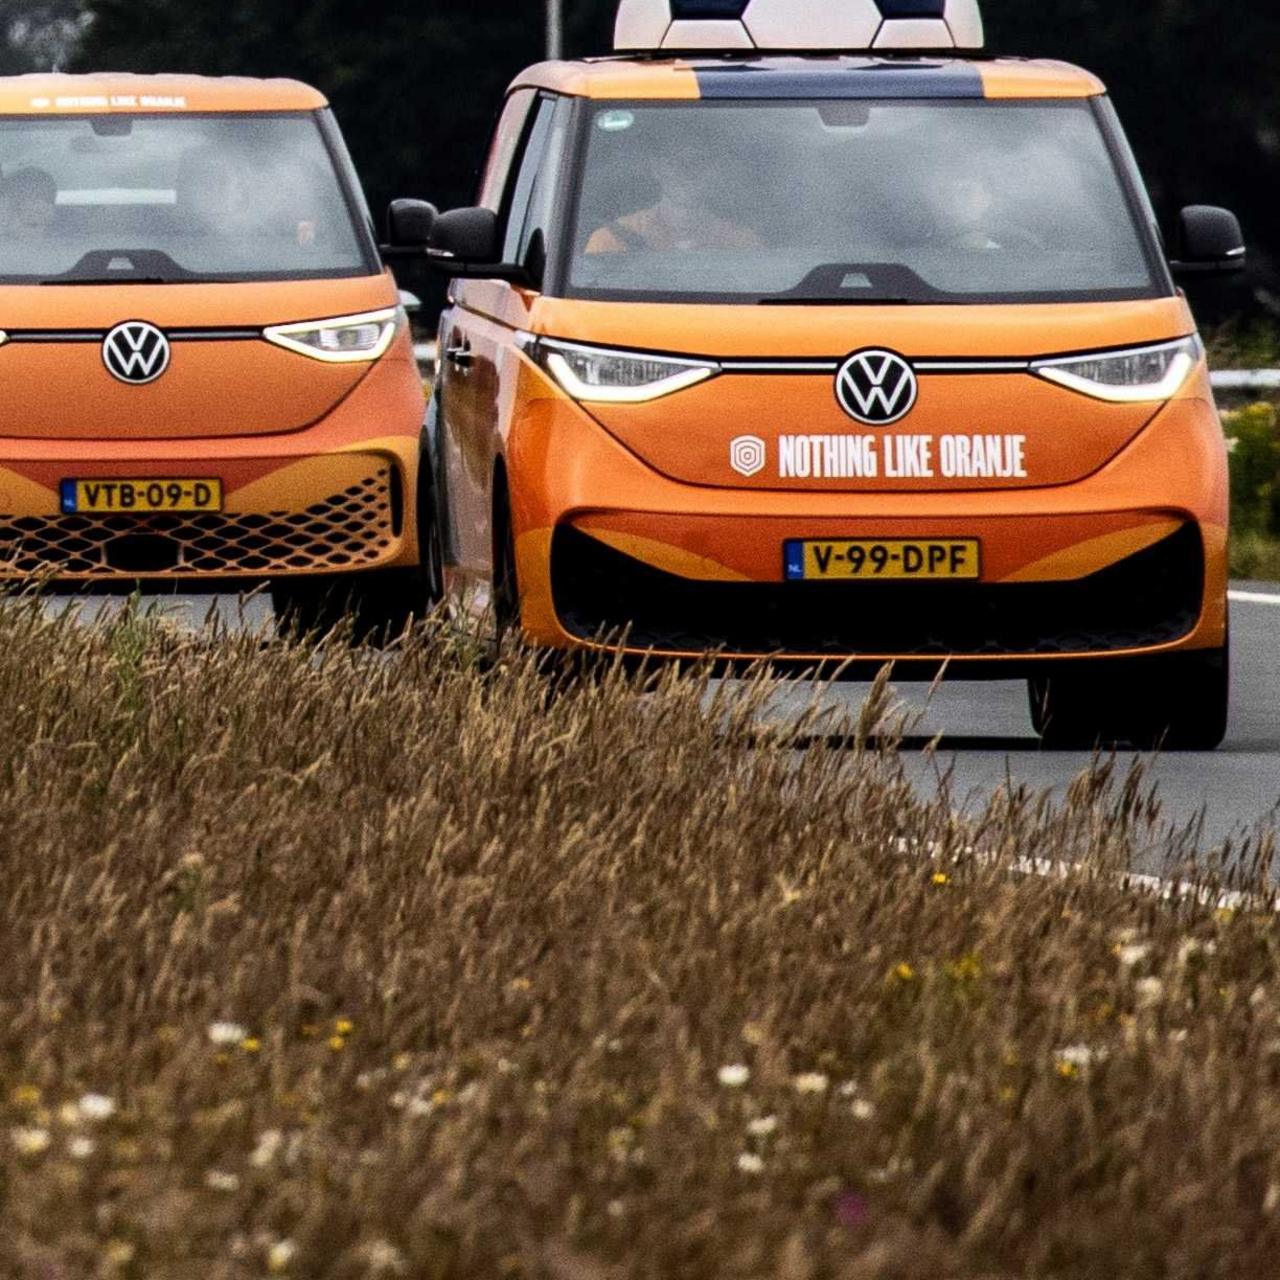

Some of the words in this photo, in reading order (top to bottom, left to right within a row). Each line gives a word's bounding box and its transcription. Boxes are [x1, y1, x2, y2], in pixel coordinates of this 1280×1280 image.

[779, 435, 877, 477] NOTHING
[884, 434, 933, 477] LIKE
[940, 434, 1027, 477] ORANJE
[83, 483, 212, 508] VTB-09-D
[812, 544, 968, 574] V-99-DPF
